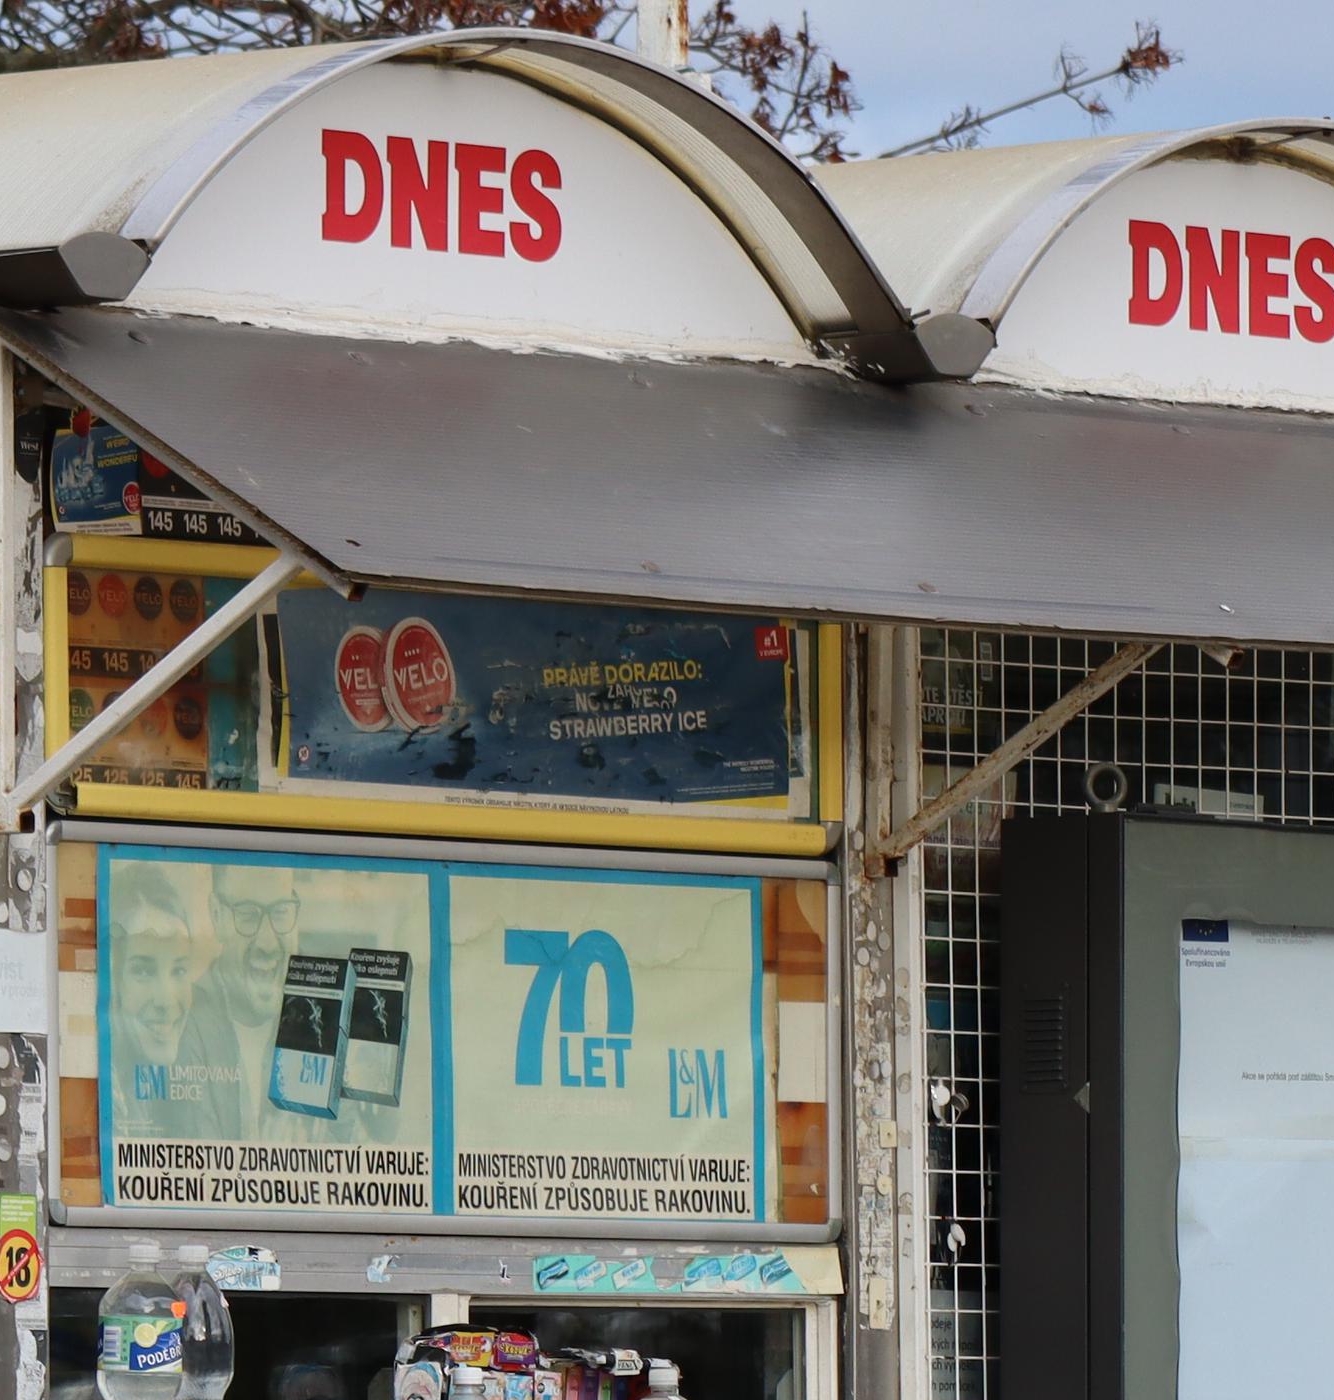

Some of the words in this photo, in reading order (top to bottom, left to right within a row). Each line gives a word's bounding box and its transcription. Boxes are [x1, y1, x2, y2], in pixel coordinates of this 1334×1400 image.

[321, 128, 562, 263] DNES
[148, 510, 173, 531] 145
[184, 512, 207, 534] 145
[217, 516, 242, 537] 145
[70, 649, 92, 670] 45
[103, 651, 129, 672] 145
[393, 656, 448, 693] VELO
[543, 660, 603, 688] PRÁVĚ
[604, 659, 703, 684] DORAZILO:
[339, 667, 382, 689] VEL
[549, 712, 673, 740] STRAWBERRY
[678, 710, 707, 731] ICE
[504, 929, 634, 1086] 70
[169, 1064, 242, 1082] LIMITOVANÁ
[559, 1036, 632, 1088] LET
[170, 1083, 203, 1100] EDICE
[668, 1048, 728, 1119] L&M
[118, 1143, 234, 1171] MINISTERSTVO
[238, 1145, 361, 1174] ZDRAVOTNICTVÍ
[366, 1150, 429, 1176] VARUJE:
[458, 1153, 566, 1180] MINISTERSTVO
[571, 1154, 684, 1182] ZDRAVOTNICTVÍ
[689, 1158, 750, 1183] VARUJE:
[118, 1172, 204, 1201] KOUŘENÍ
[210, 1173, 321, 1204] ZPŮSOBUJE
[327, 1181, 429, 1208] RAKOVINU.
[458, 1182, 538, 1210] KOUŘENÍ
[544, 1182, 649, 1212] ZPŮSOBUJE
[655, 1189, 751, 1214] RAKOVINU.
[5, 1246, 31, 1288] 18
